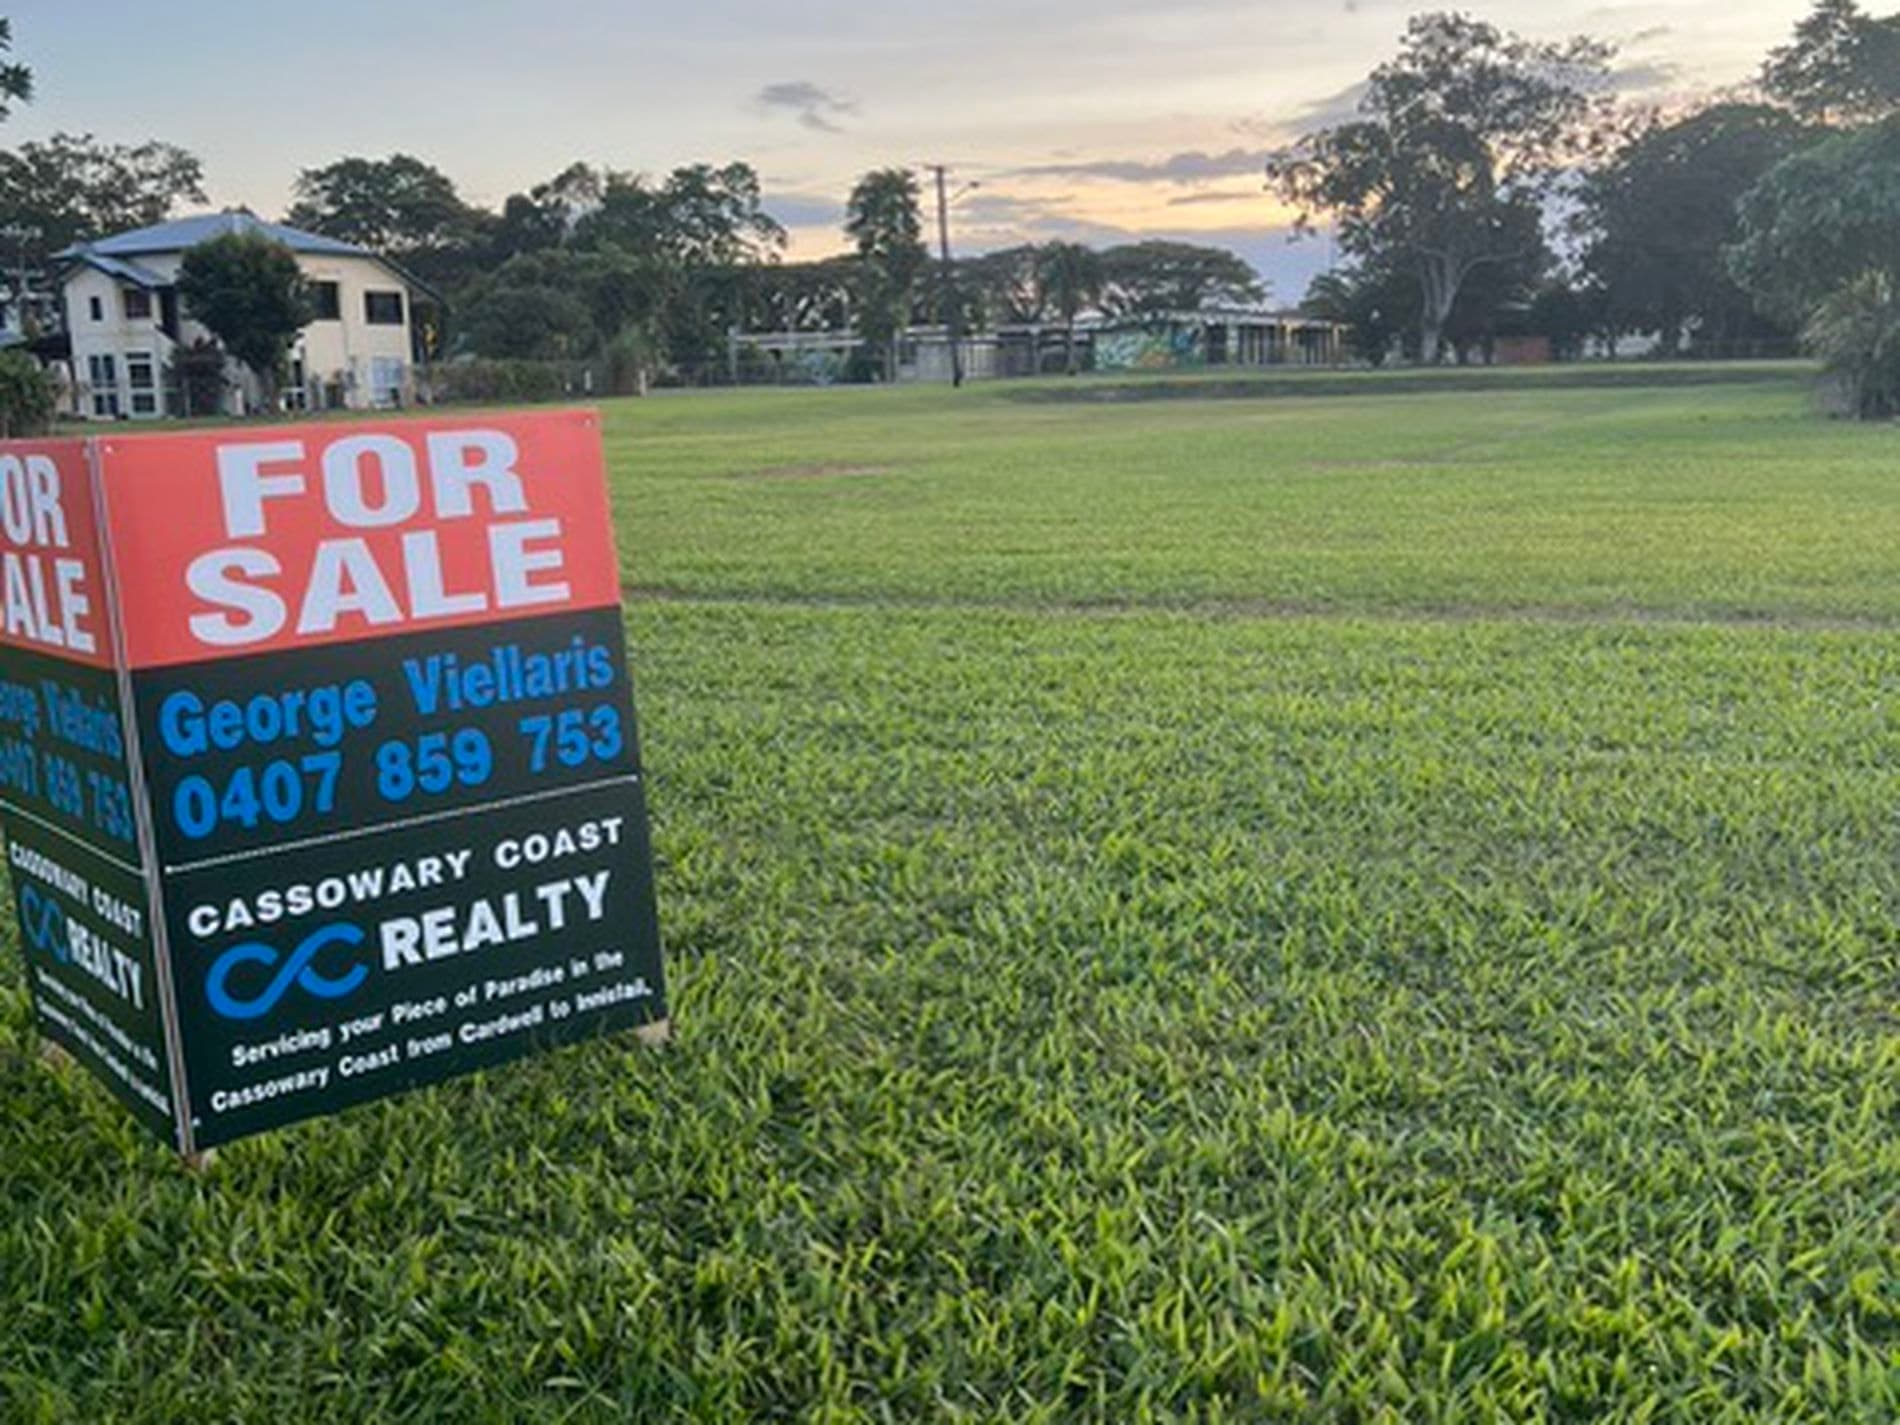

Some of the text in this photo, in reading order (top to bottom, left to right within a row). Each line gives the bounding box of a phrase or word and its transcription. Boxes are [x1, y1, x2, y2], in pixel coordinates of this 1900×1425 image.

[216, 428, 529, 540] FOR
[0, 553, 96, 653] ALE
[185, 518, 571, 645] SALE
[160, 679, 377, 757] George
[403, 634, 615, 715] Viellaris
[173, 704, 623, 839] 0407 859 753
[188, 818, 624, 937] CASSOWARY COAST
[379, 871, 611, 971] REALTY
[211, 1067, 330, 1112] Cassowary
[338, 1044, 399, 1077] Coast
[549, 1001, 570, 1018] to
[231, 951, 624, 1067] Servicing your Piece of Paradise in the
